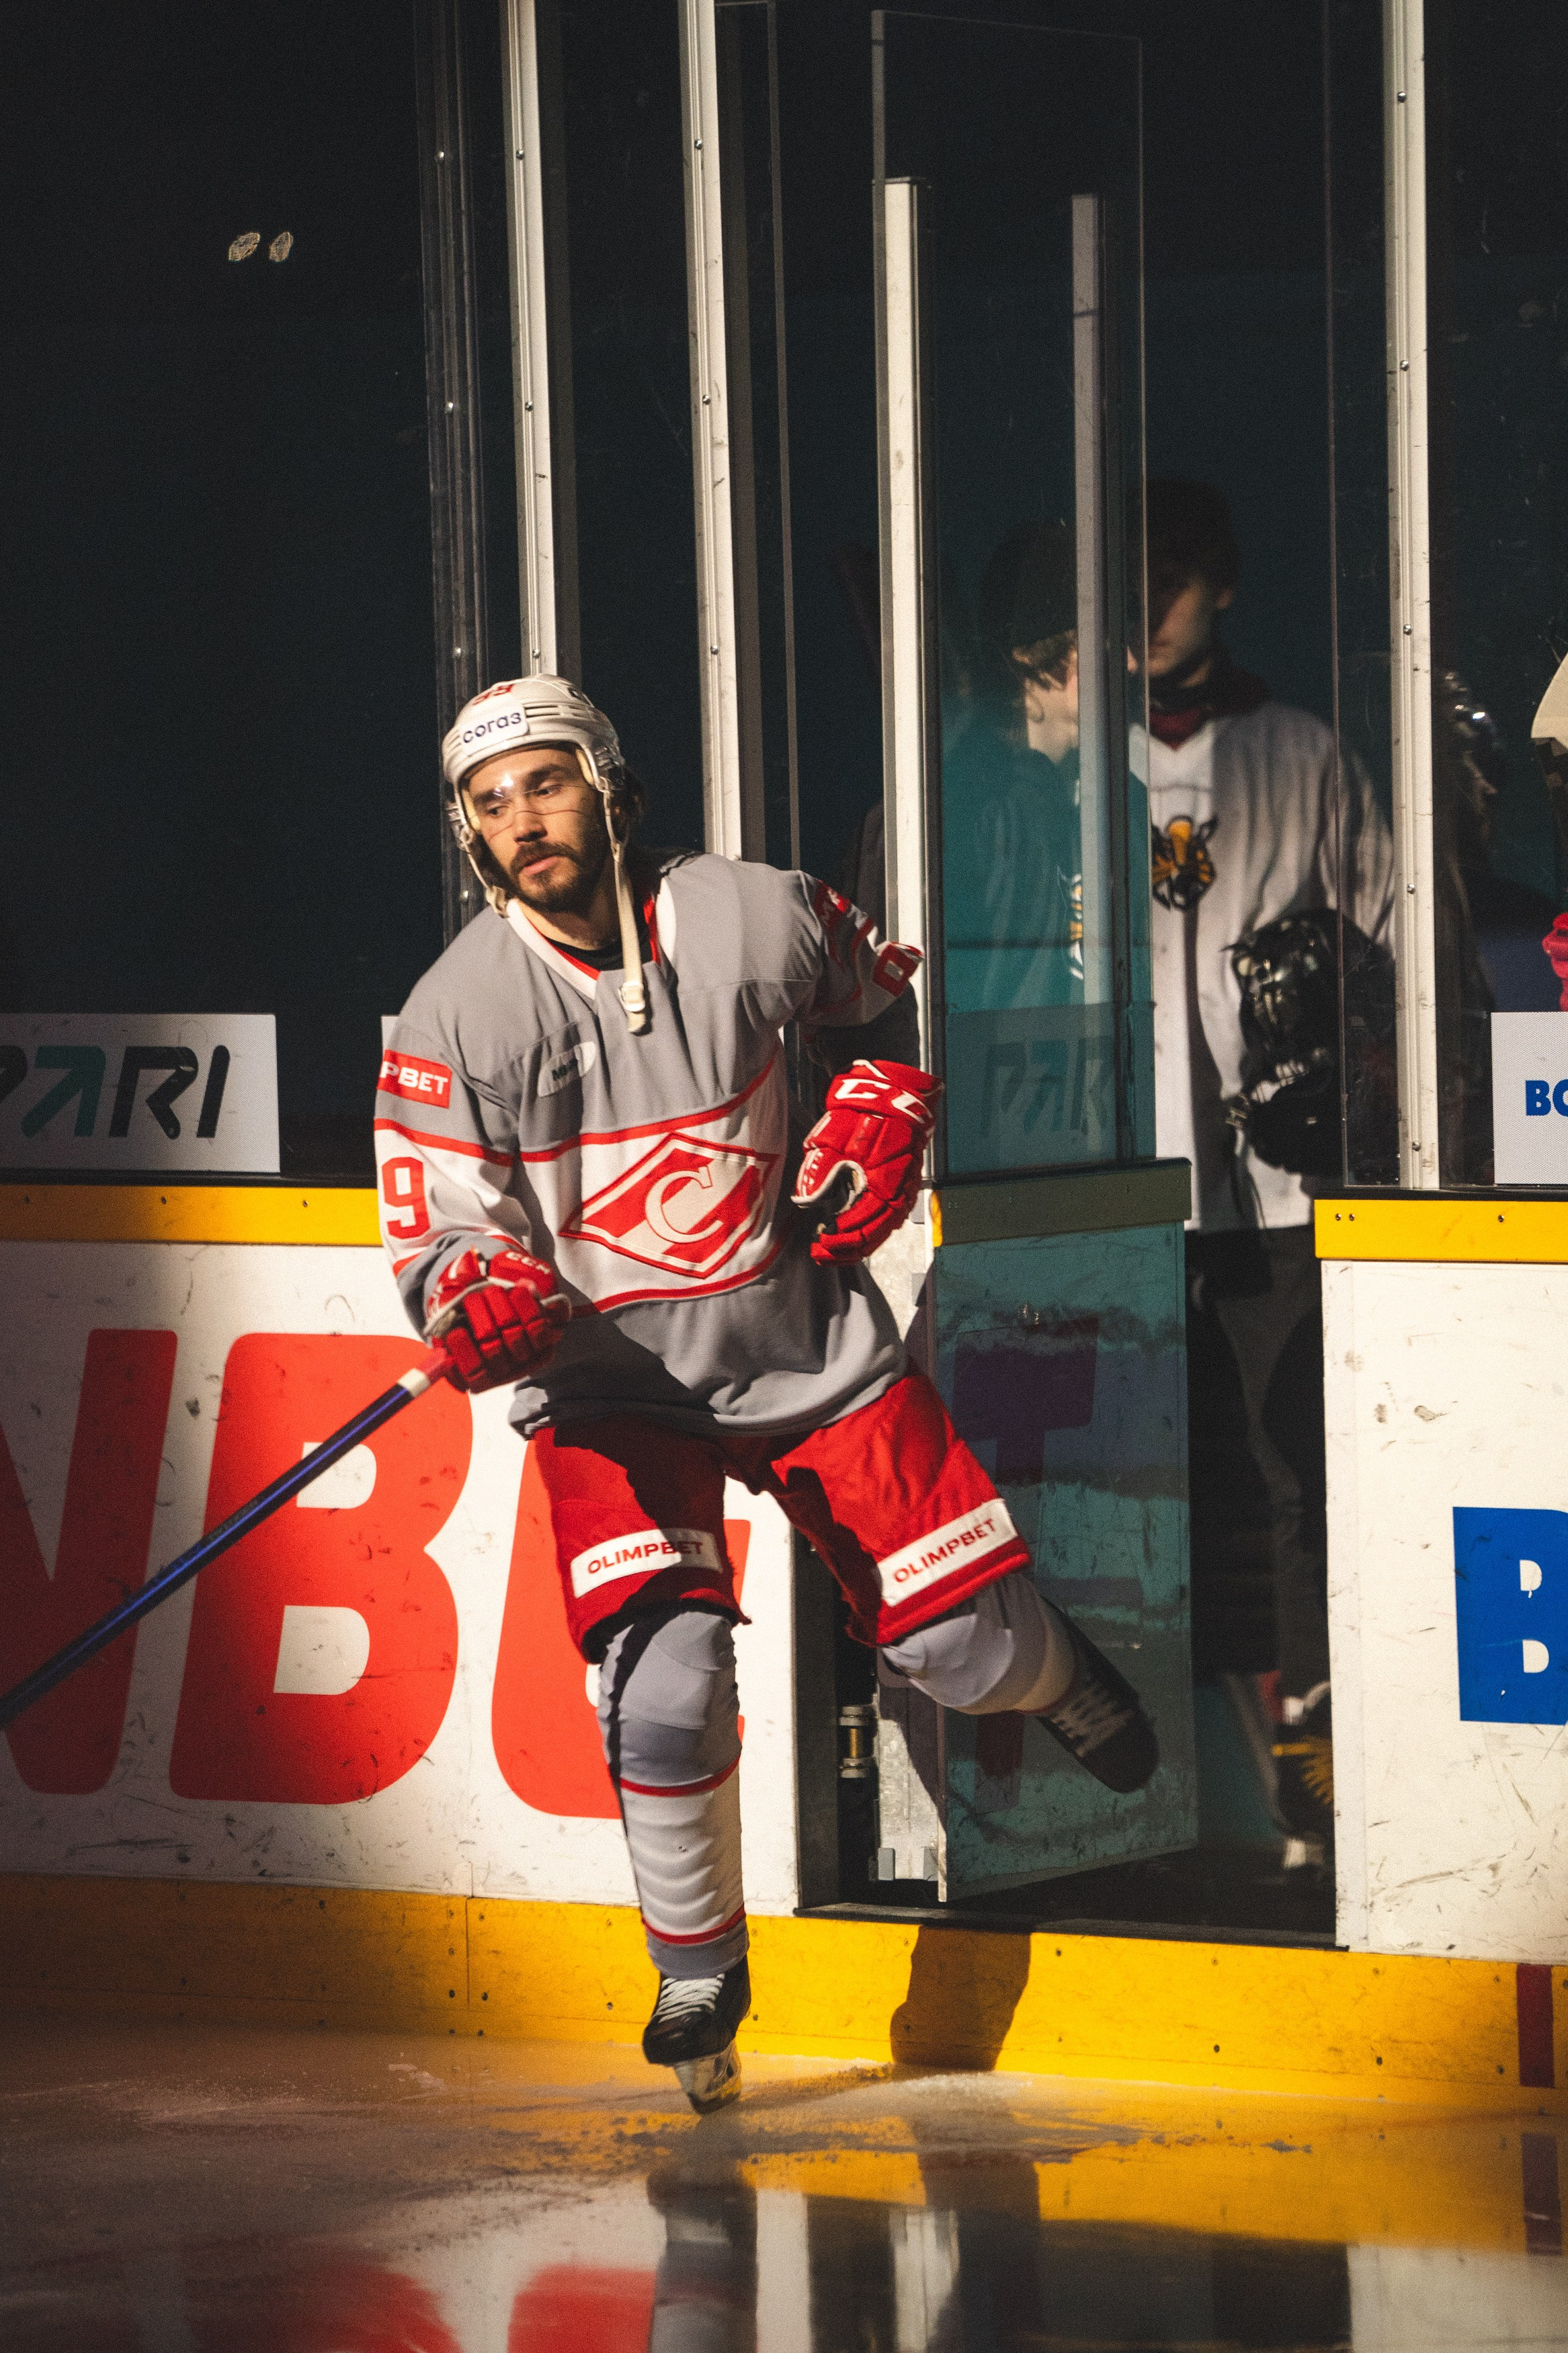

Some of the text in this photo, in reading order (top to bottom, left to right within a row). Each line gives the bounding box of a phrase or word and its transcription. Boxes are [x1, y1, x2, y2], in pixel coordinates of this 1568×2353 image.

[462, 711, 522, 744] согаз
[835, 1078, 934, 1135] CC
[382, 1156, 430, 1240] 9
[587, 1540, 704, 1575] OLIMPBET
[893, 1518, 997, 1583] OLIMPBET
